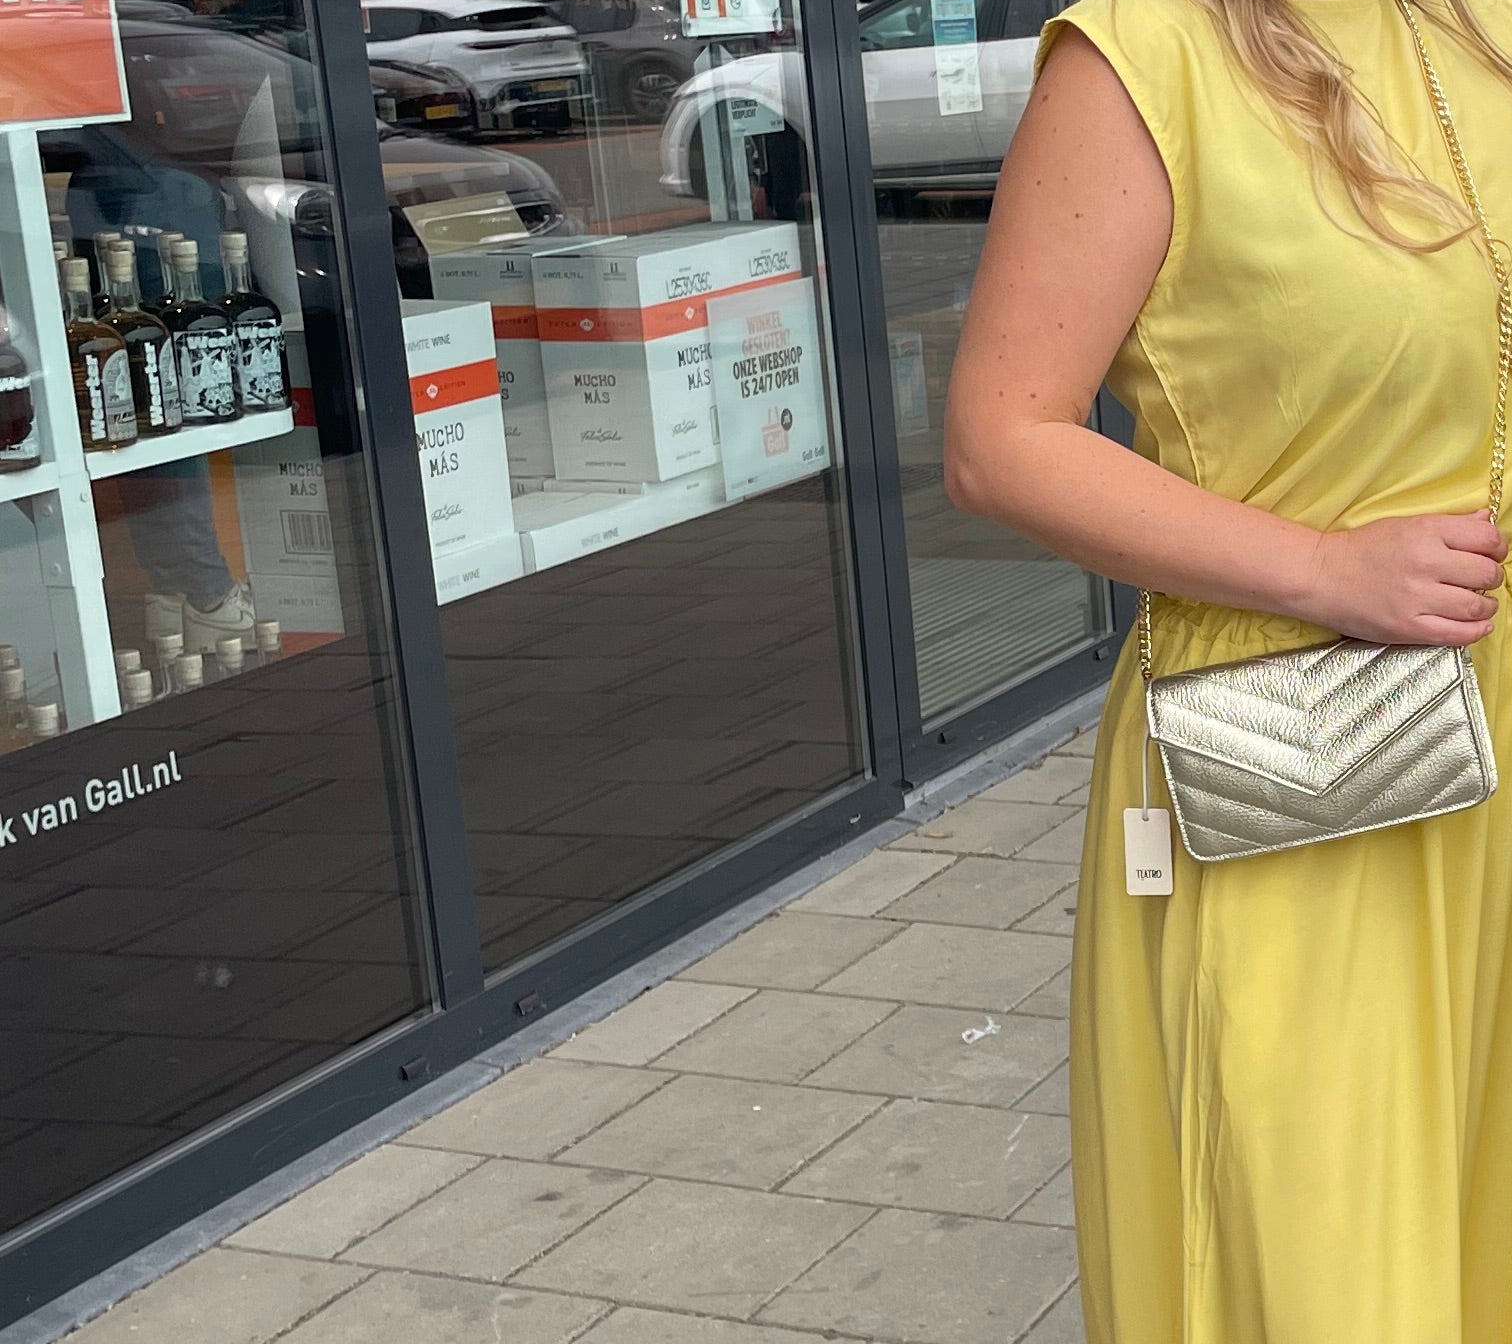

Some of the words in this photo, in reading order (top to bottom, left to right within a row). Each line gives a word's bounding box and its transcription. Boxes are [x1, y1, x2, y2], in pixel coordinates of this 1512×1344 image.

[431, 333, 451, 349] WINE
[733, 355, 757, 380] ONZE
[759, 345, 803, 374] WEBSHOP
[574, 374, 617, 387] MUCHO
[741, 380, 750, 399] IS
[752, 373, 773, 397] 24/7
[774, 366, 800, 390] OPEN
[416, 422, 465, 452] MUCHO
[430, 451, 460, 478] MÁS
[462, 567, 481, 583] WINE
[22, 795, 78, 836] van
[85, 750, 182, 813] Gall.nl
